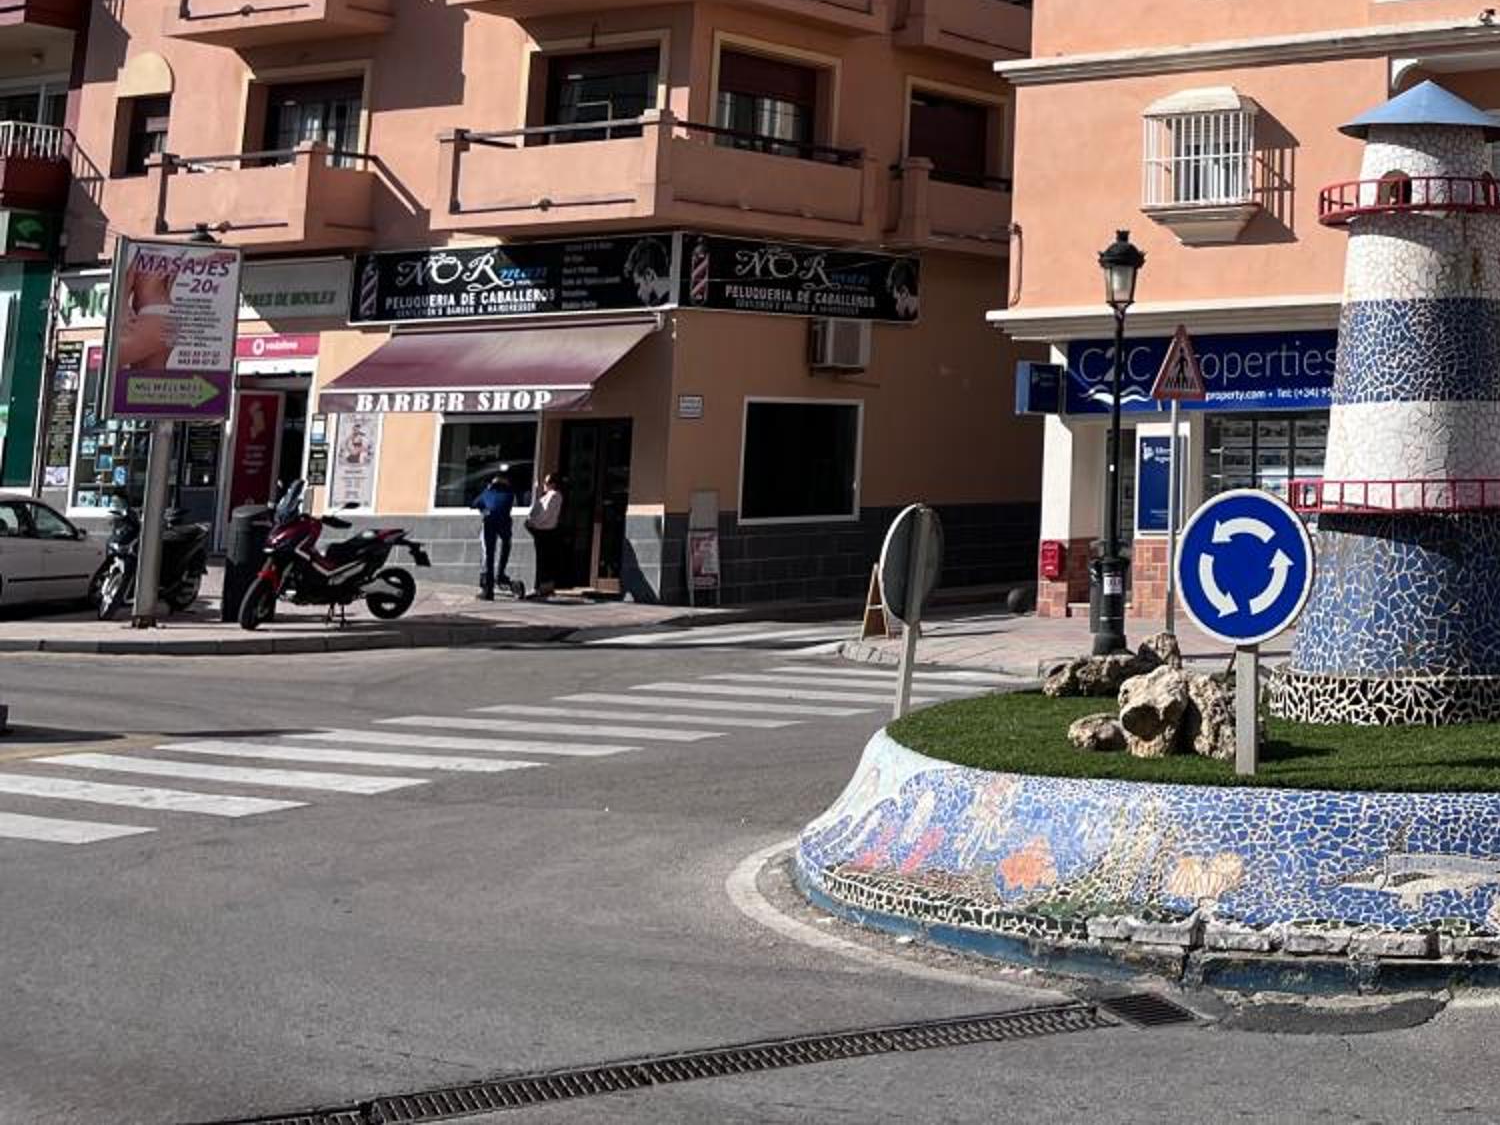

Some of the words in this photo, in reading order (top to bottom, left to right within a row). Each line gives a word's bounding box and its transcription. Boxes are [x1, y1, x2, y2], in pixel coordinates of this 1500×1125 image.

[137, 255, 230, 276] MASAJES
[385, 294, 455, 310] PELUQUERIA
[461, 292, 475, 306] DE
[481, 288, 555, 304] CABALLEROS
[725, 285, 792, 302] PELUQUERIA
[797, 291, 810, 304] DE
[815, 292, 876, 308] CABALLEROS
[1194, 340, 1336, 387] operties
[356, 393, 464, 413] BARBER
[477, 390, 552, 411] SHOP
